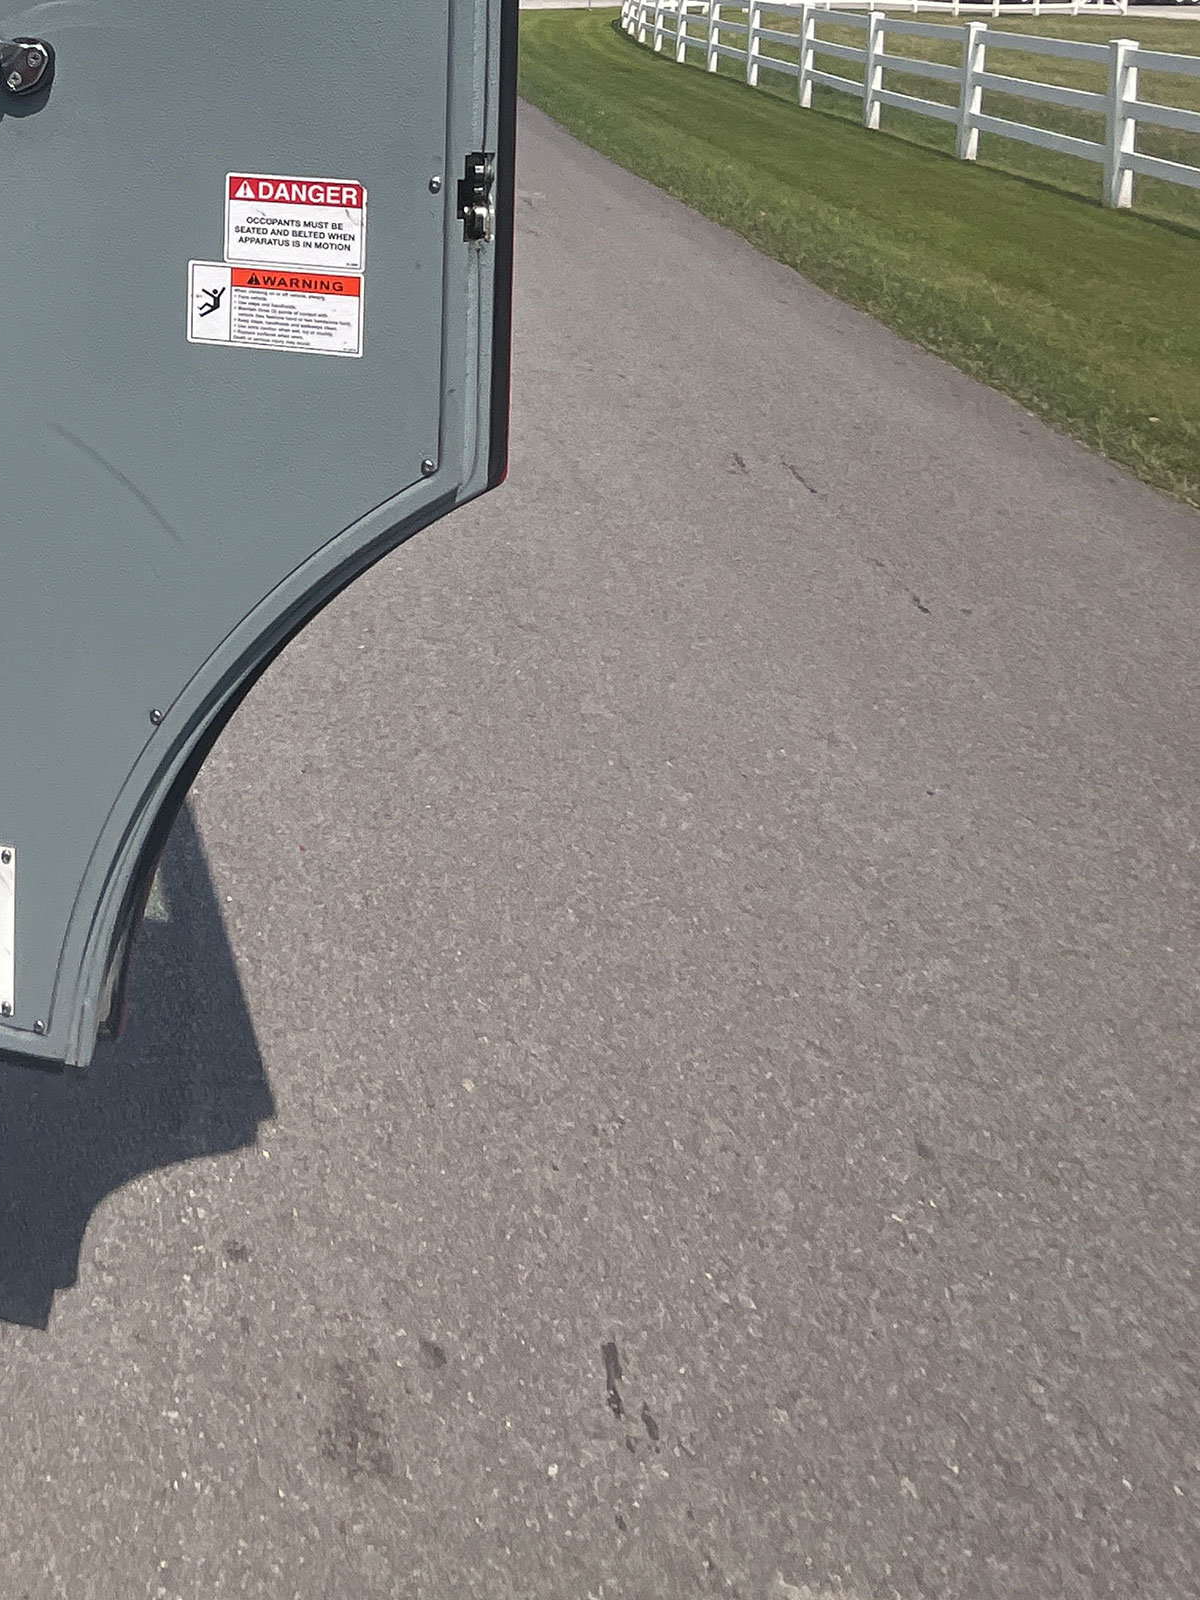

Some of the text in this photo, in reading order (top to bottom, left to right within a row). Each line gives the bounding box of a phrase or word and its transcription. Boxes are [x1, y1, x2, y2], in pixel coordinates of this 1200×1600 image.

[258, 182, 357, 206] DANGER
[246, 216, 344, 230] OCCUPANTS MUST BE
[234, 225, 355, 241] SEATED AND BELTED WHEN
[238, 236, 290, 247] APPARATUS
[314, 242, 351, 252] MOTION
[262, 275, 344, 292] WARNING
